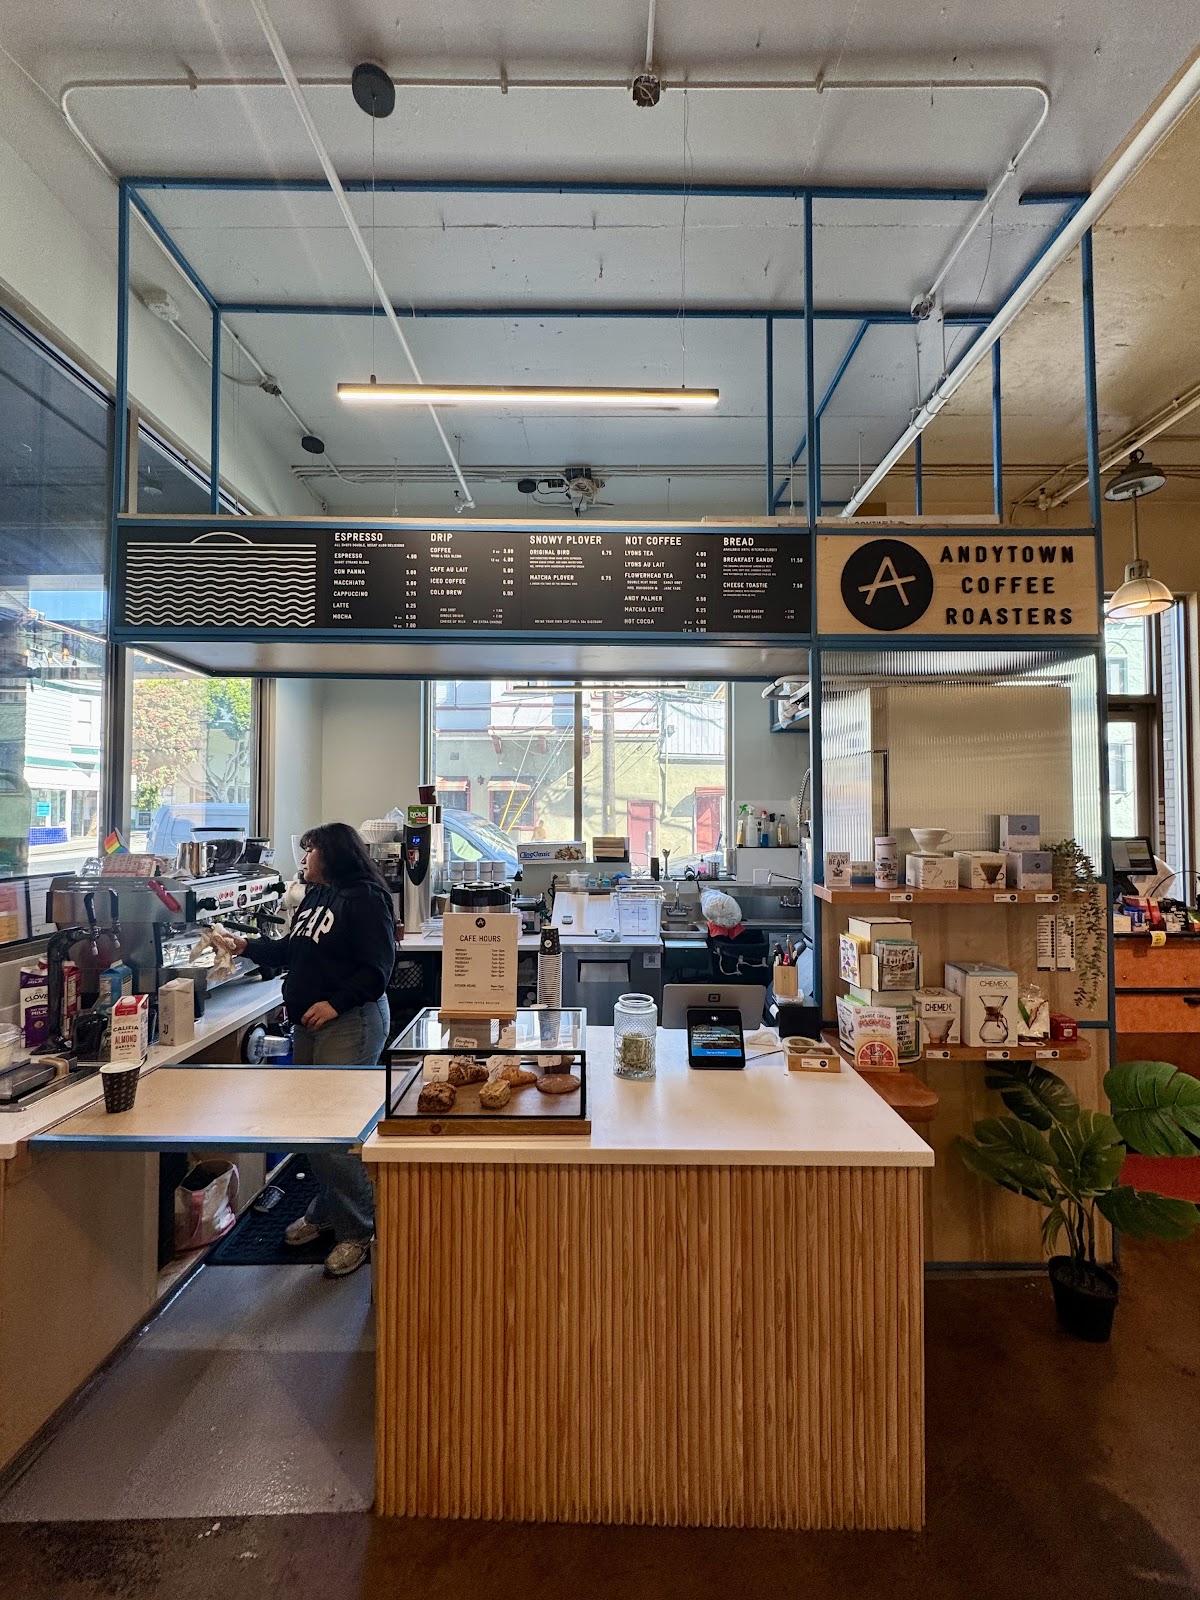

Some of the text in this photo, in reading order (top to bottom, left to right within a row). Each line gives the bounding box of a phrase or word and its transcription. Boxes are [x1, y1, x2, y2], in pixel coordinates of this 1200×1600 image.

[334, 532, 383, 542] ESPRESSO
[430, 533, 453, 542] DRIP
[529, 535, 602, 545] SNOWY PLOVER
[625, 536, 682, 546] NOT COFFEE
[723, 537, 754, 546] BREAD
[940, 546, 1074, 563] ANDYTOWN
[961, 577, 1055, 594] COFFEE
[946, 608, 1073, 625] ROASTERS
[925, 1003, 952, 1012] CHEMEX
[115, 1034, 137, 1044] ALMOND
